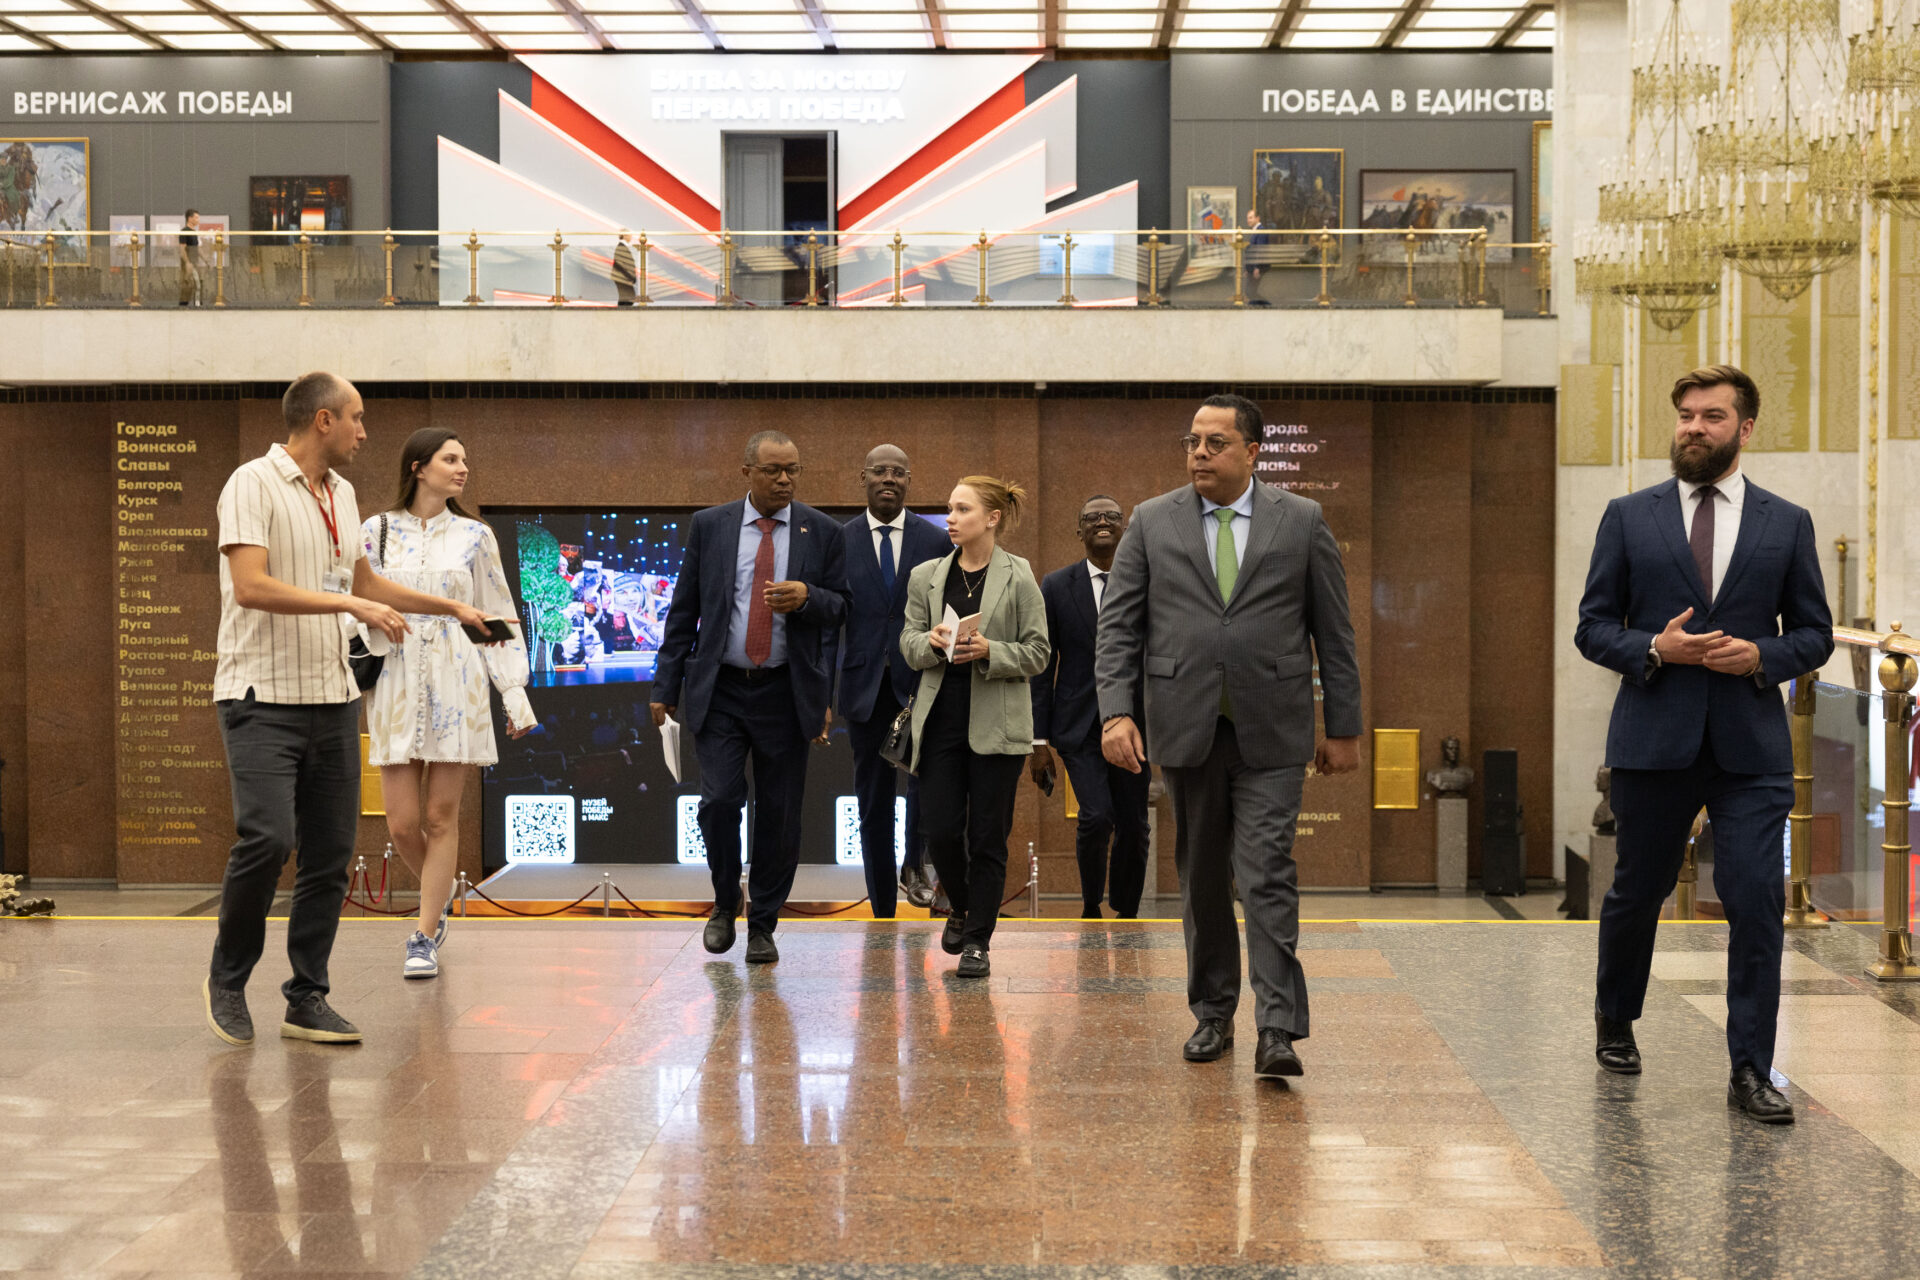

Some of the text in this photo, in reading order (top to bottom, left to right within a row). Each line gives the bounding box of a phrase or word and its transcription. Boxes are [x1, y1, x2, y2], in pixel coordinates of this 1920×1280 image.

[651, 69, 907, 91] БИТВА ЗА МОСКВУ
[14, 91, 292, 116] ВЕРНИСАЖ ПОБЕДЫ
[1262, 89, 1380, 115] ПОБЕДА
[1391, 89, 1407, 112] В
[651, 97, 905, 124] ПЕРВАЯ ПОБЕДА
[117, 422, 177, 438] Города
[1262, 424, 1309, 438] рода
[117, 440, 197, 453] Воинской
[1259, 440, 1328, 453] оинско
[117, 458, 170, 472] Славы
[1254, 461, 1300, 472] лавы
[118, 479, 183, 492] Белгород
[118, 494, 158, 508] Курск
[118, 510, 154, 523] Орел
[118, 525, 208, 538] Владикавказ
[118, 541, 185, 552] Малгобек
[119, 603, 181, 616] Воронеж
[119, 619, 151, 632] Луга
[119, 633, 189, 647] Полярный
[119, 665, 166, 678] Туапсе
[120, 680, 178, 692] Великие
[582, 798, 607, 806] МУЗЕЙ
[582, 806, 613, 814] ПОБЕДЫ
[588, 813, 609, 821] МАКС
